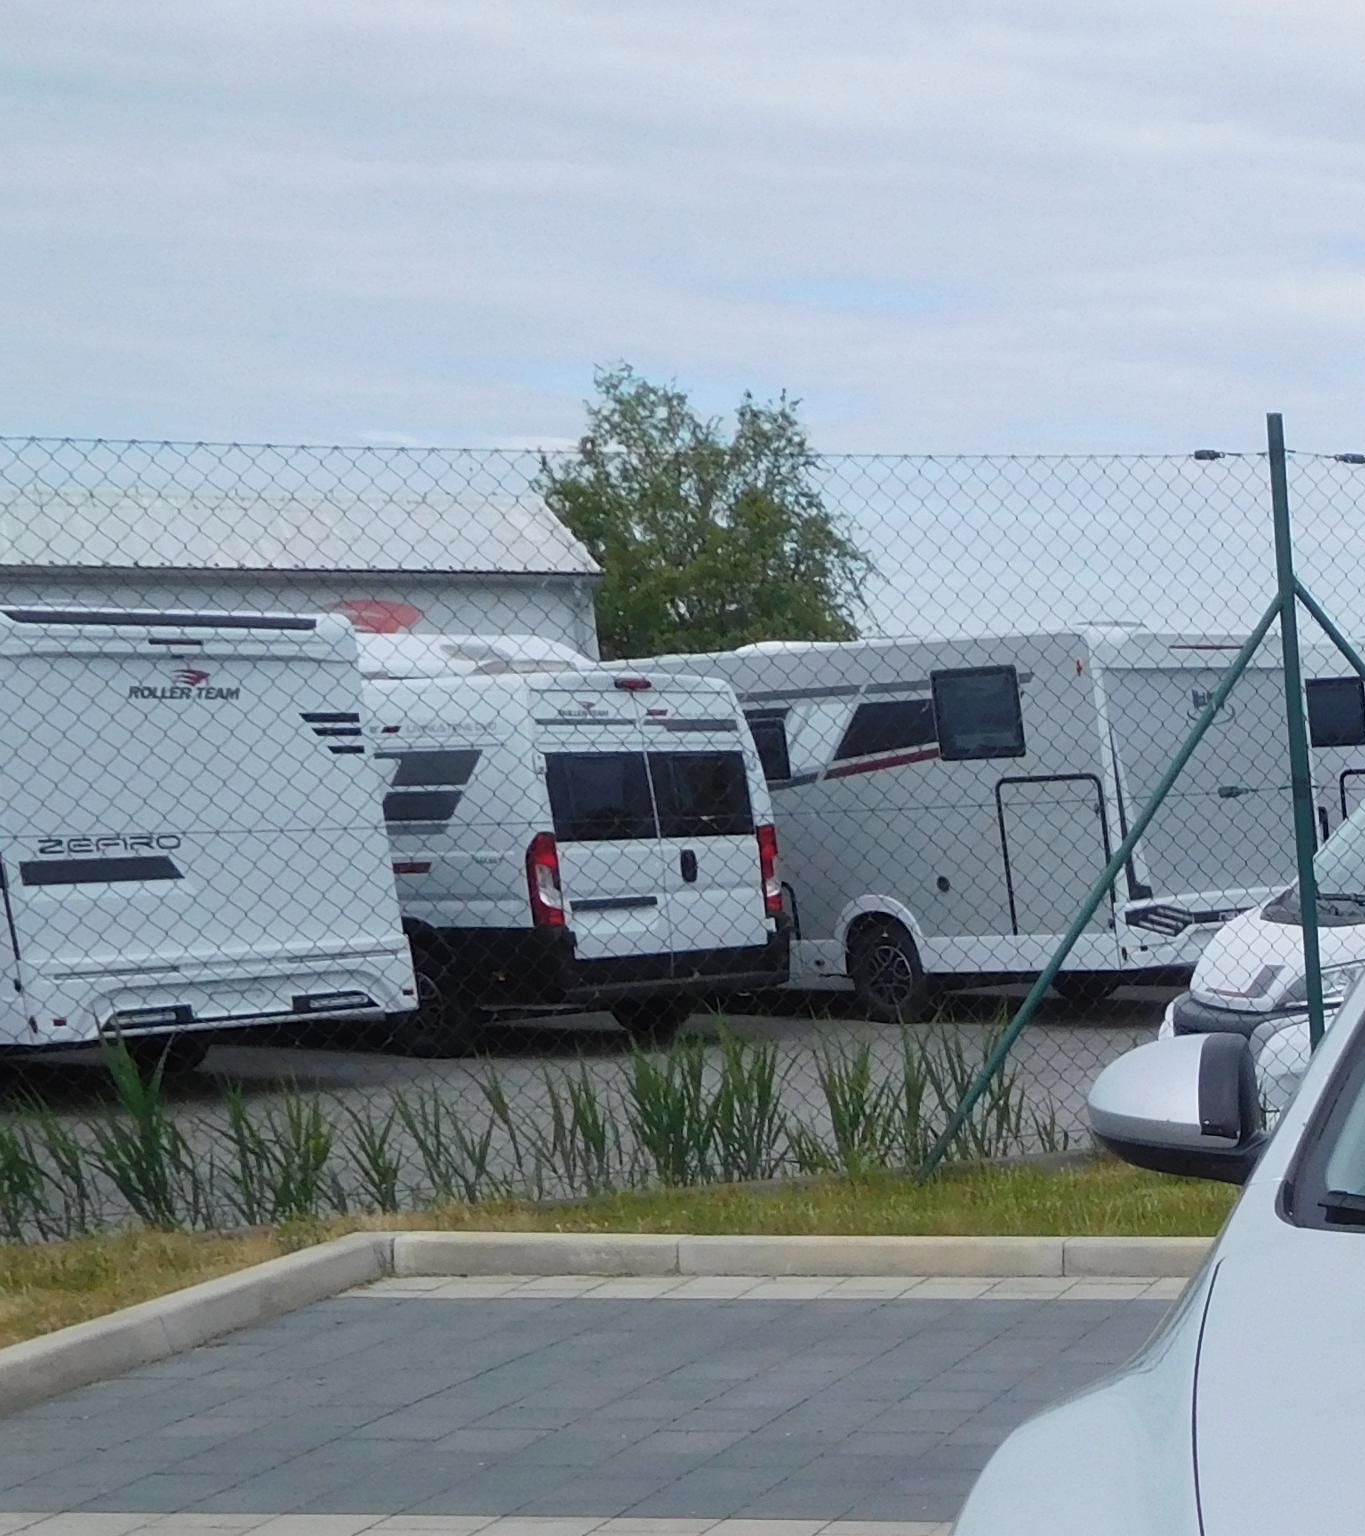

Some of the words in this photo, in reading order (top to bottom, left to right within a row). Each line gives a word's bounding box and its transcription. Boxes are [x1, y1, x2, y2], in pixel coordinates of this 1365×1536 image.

[128, 685, 192, 700] ROLLER
[196, 686, 241, 700] TEAM
[38, 834, 181, 854] ZEFIRO
